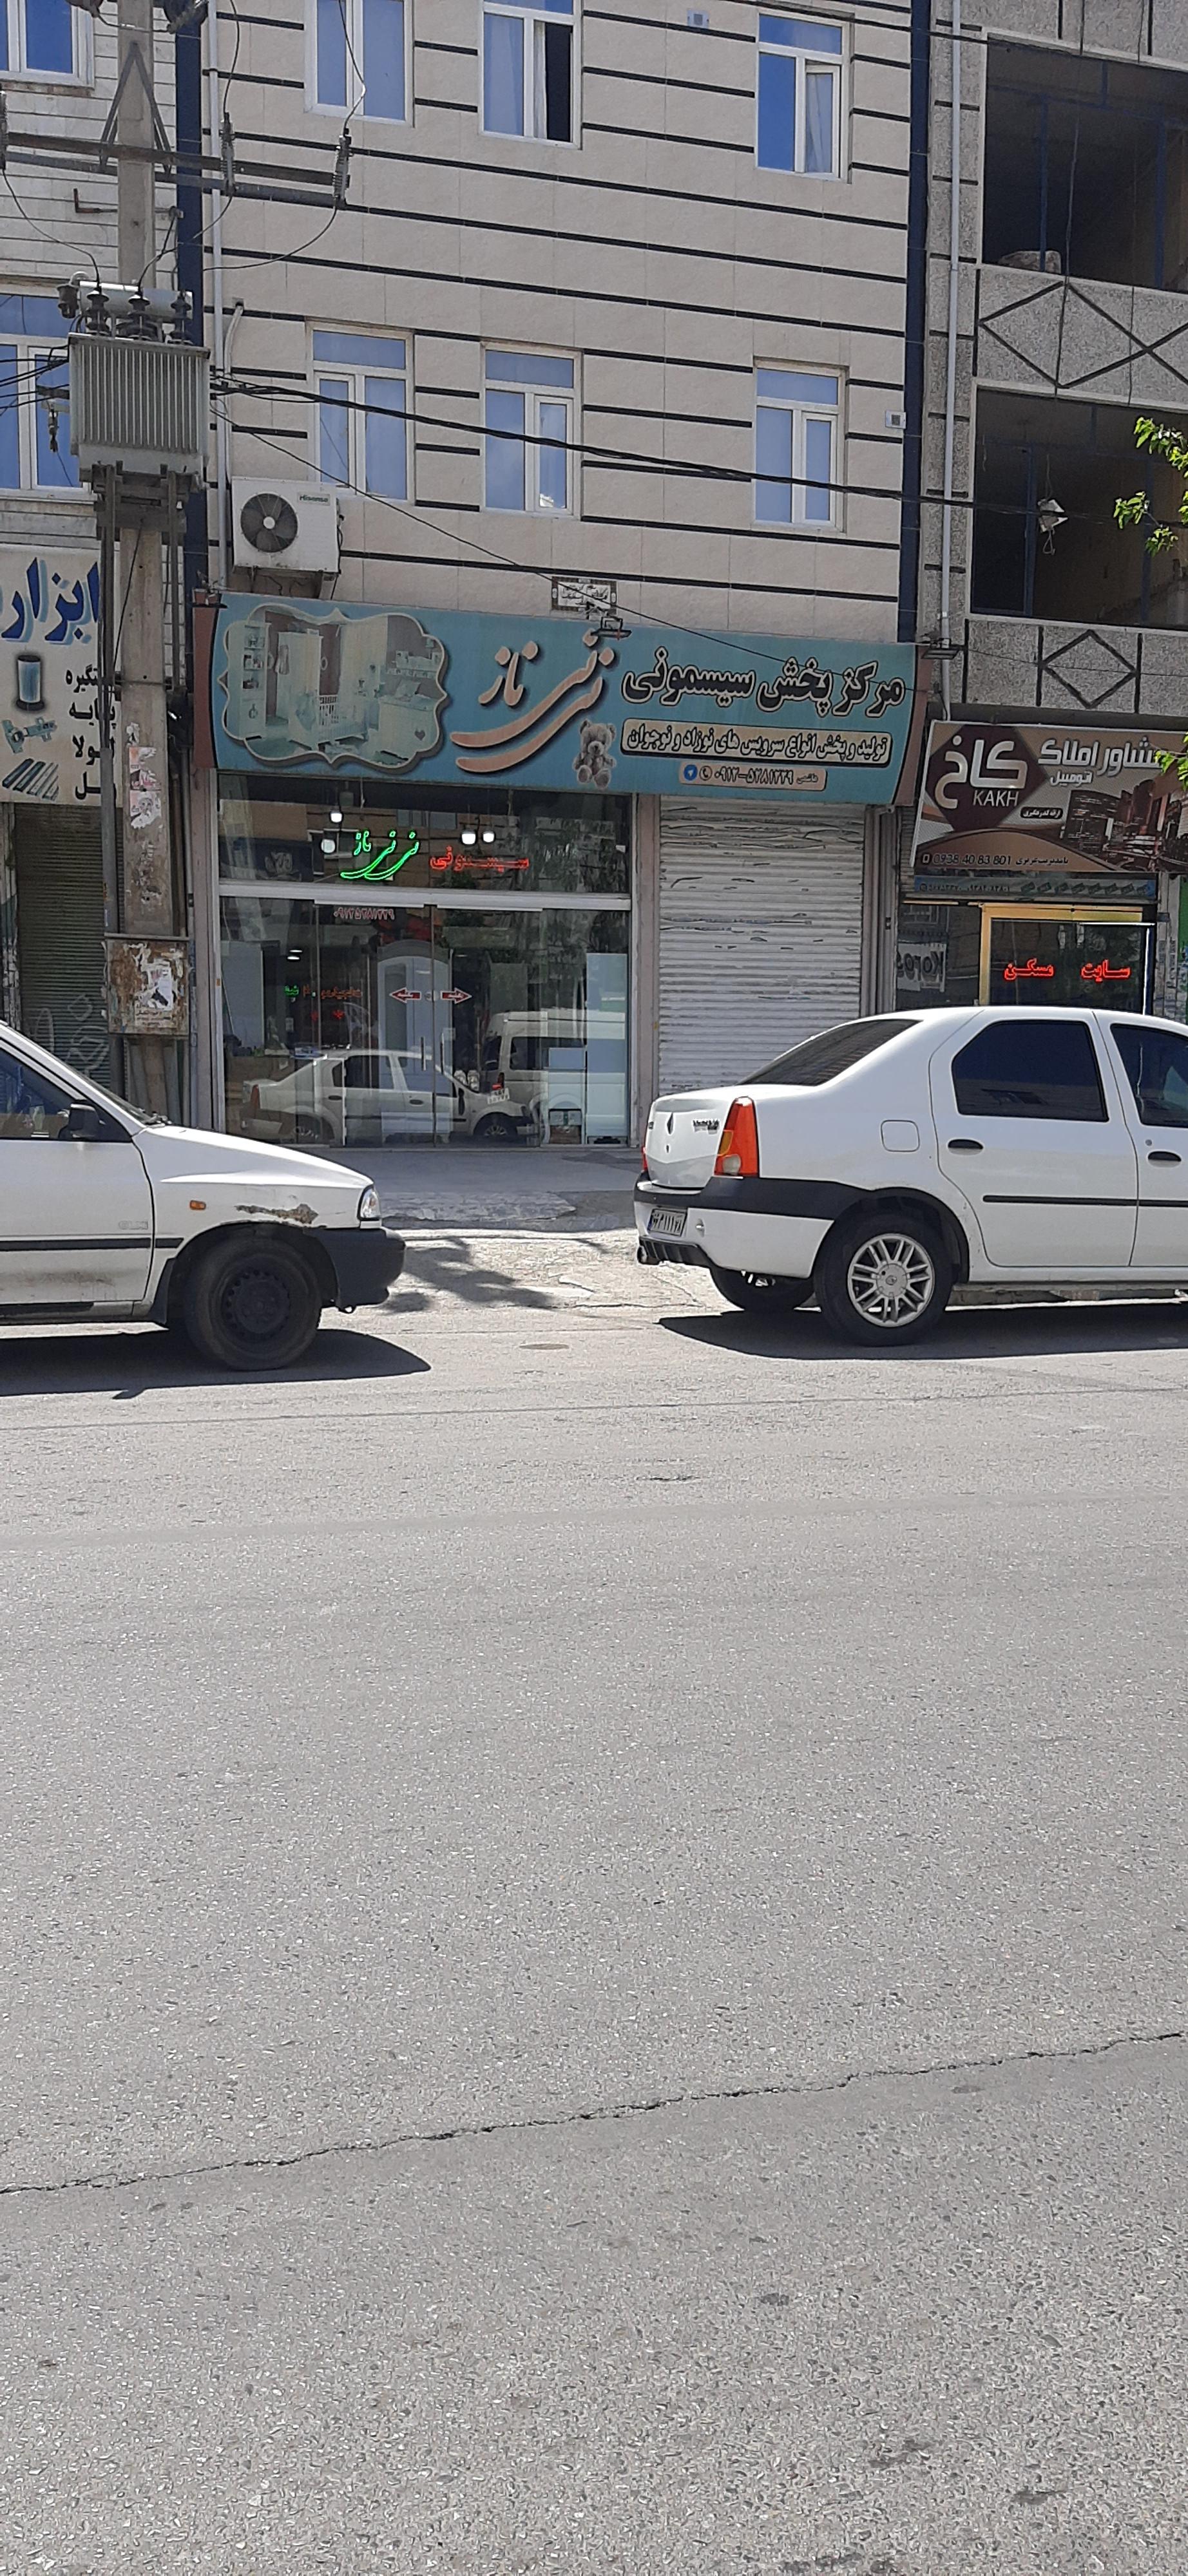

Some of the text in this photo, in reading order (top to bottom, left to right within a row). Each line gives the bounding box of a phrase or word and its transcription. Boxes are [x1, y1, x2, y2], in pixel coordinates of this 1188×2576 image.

[1, 556, 100, 641] ابزار
[478, 640, 539, 706] ناز
[622, 646, 905, 718] مرکز پخش سیسمونی
[628, 723, 888, 762] تولید و پخش انواع سرویس های نوزاد و نوجوان
[1038, 736, 1164, 776] شاور املاک
[935, 735, 1028, 810] کاخ
[973, 790, 1019, 807] KAKH
[934, 854, 1011, 865] 0938 40 83 801
[1004, 958, 1131, 983] سایت مسکن
